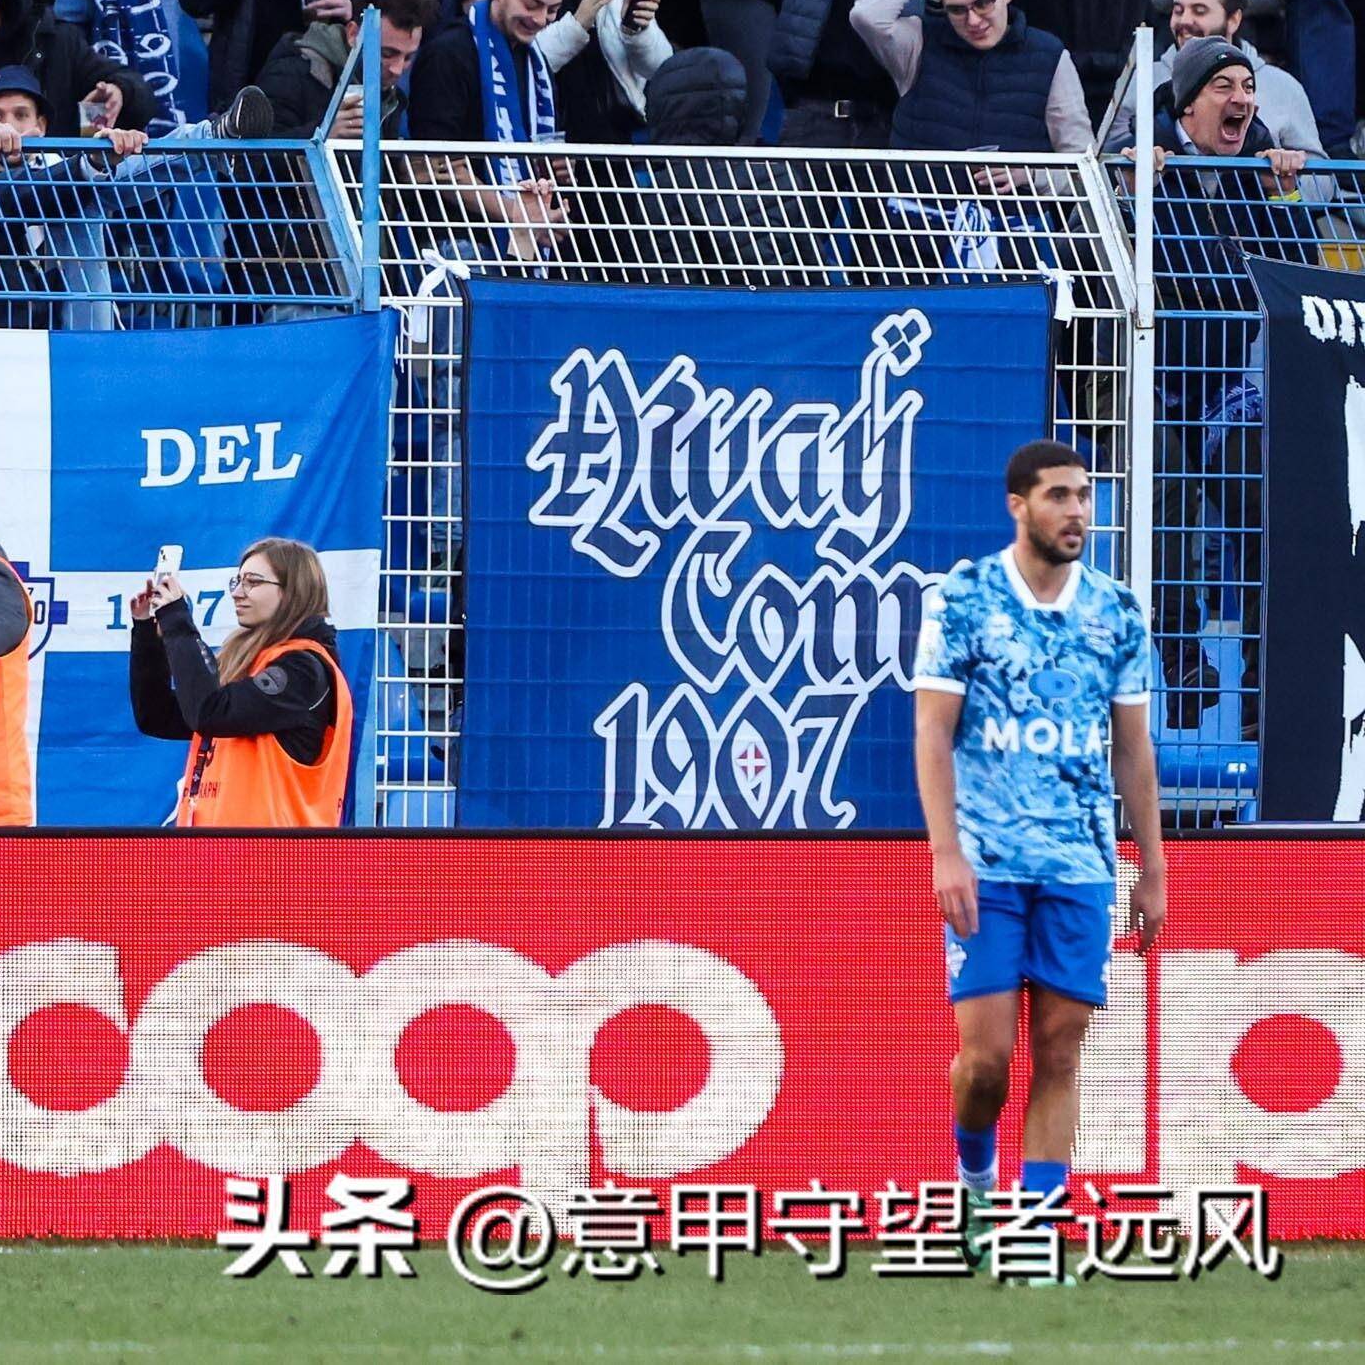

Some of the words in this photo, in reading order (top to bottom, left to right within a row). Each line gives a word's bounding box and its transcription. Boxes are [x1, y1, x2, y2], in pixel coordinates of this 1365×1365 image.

[140, 421, 303, 489] DEL
[526, 308, 932, 578] Away
[106, 590, 225, 630] 17
[661, 520, 974, 693] Com
